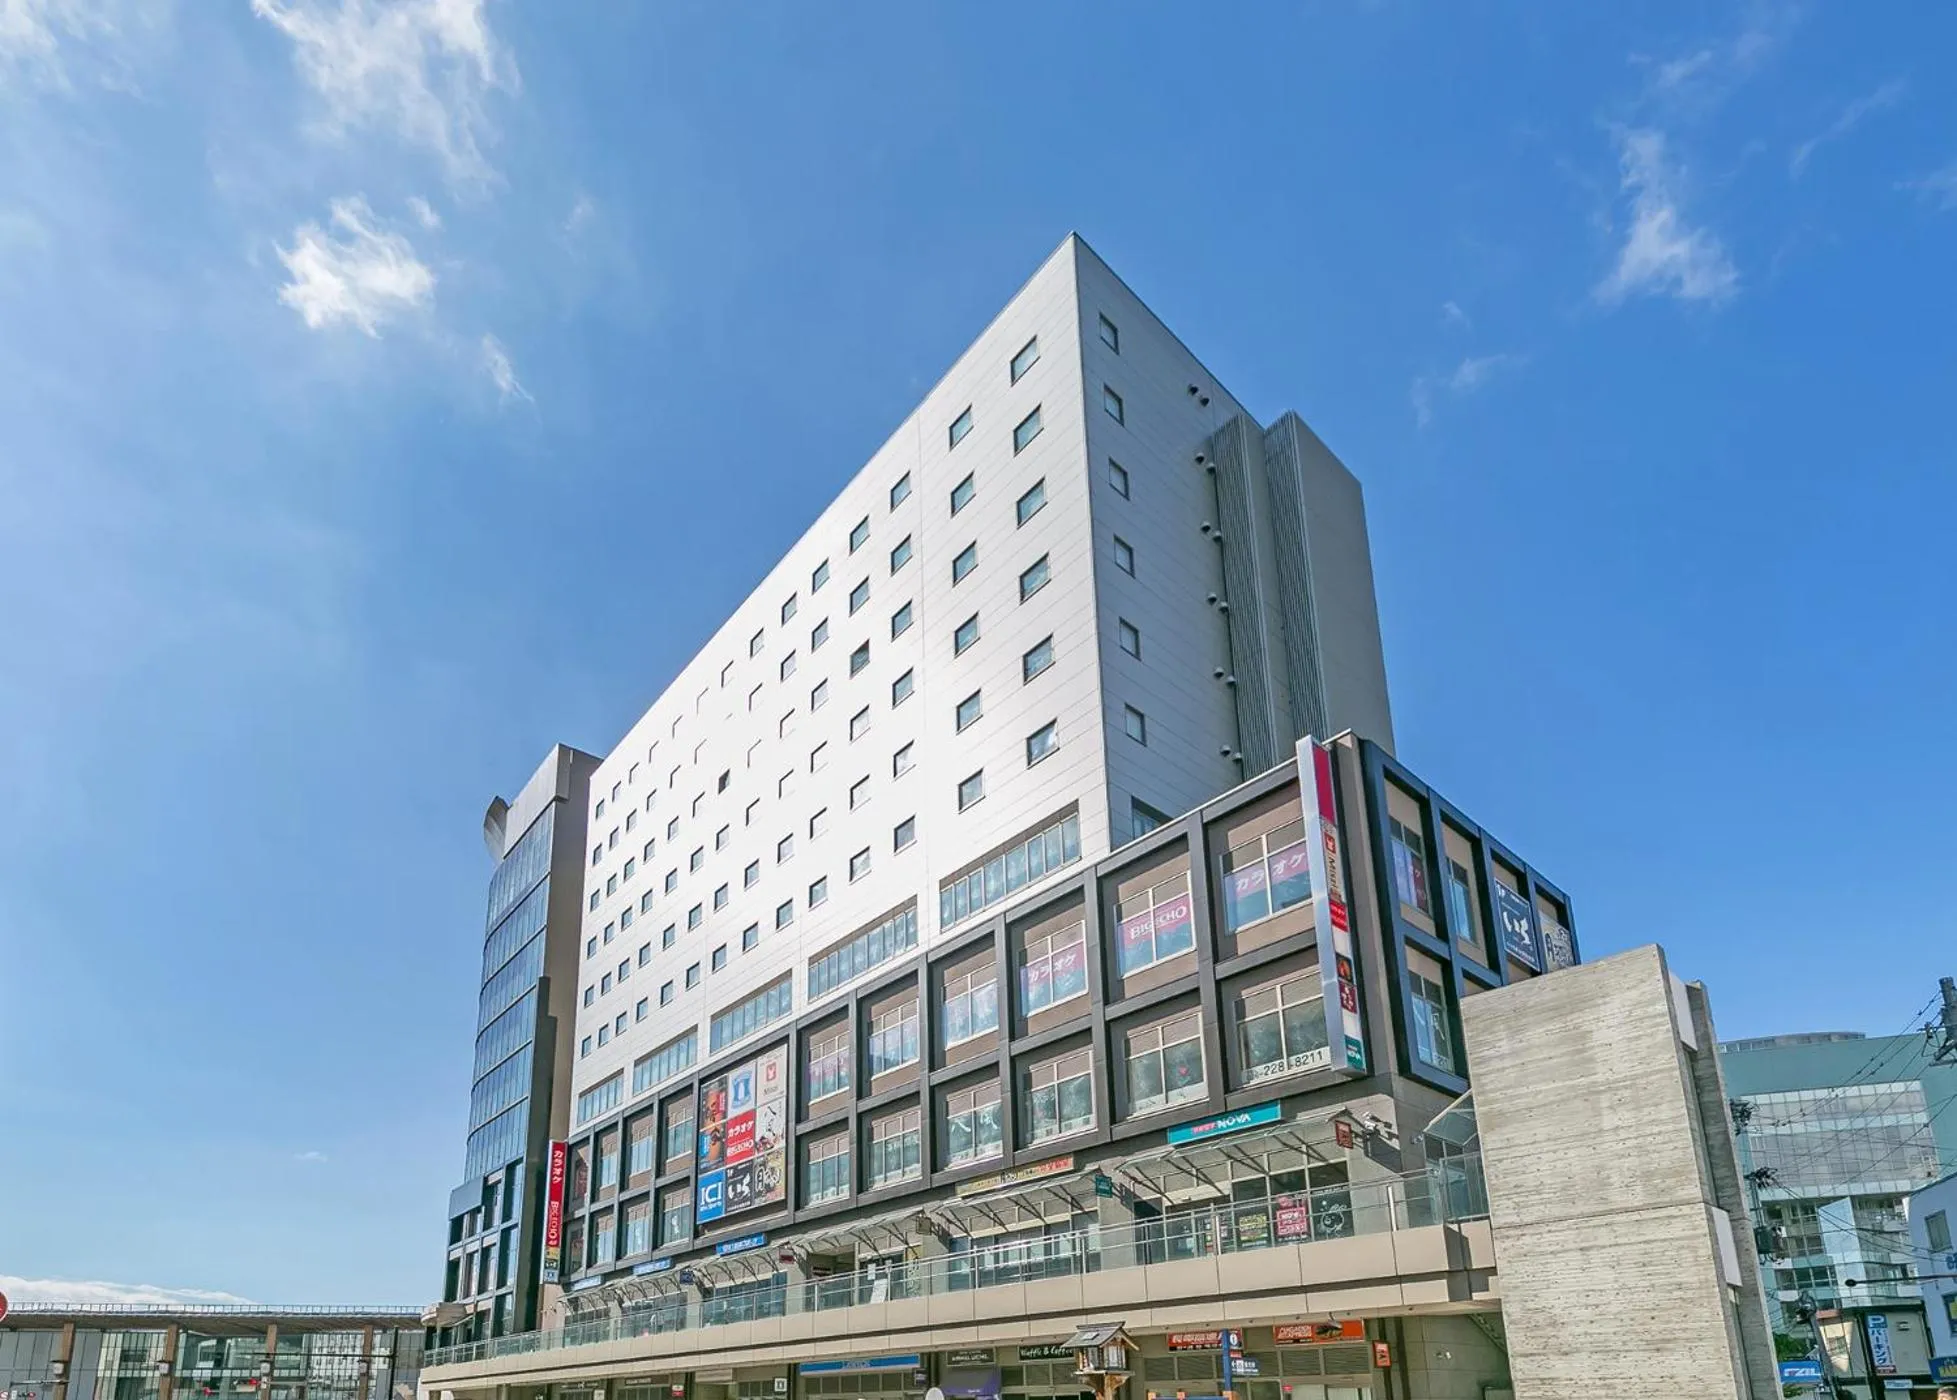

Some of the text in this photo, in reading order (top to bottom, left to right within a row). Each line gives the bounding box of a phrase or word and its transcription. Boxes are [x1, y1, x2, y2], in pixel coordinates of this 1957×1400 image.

[1235, 852, 1306, 890] カラオケ
[727, 1120, 754, 1139] カラオケ
[1216, 1112, 1252, 1129] NOVA
[552, 1150, 564, 1184] カラオケ
[700, 1181, 722, 1205] ICI
